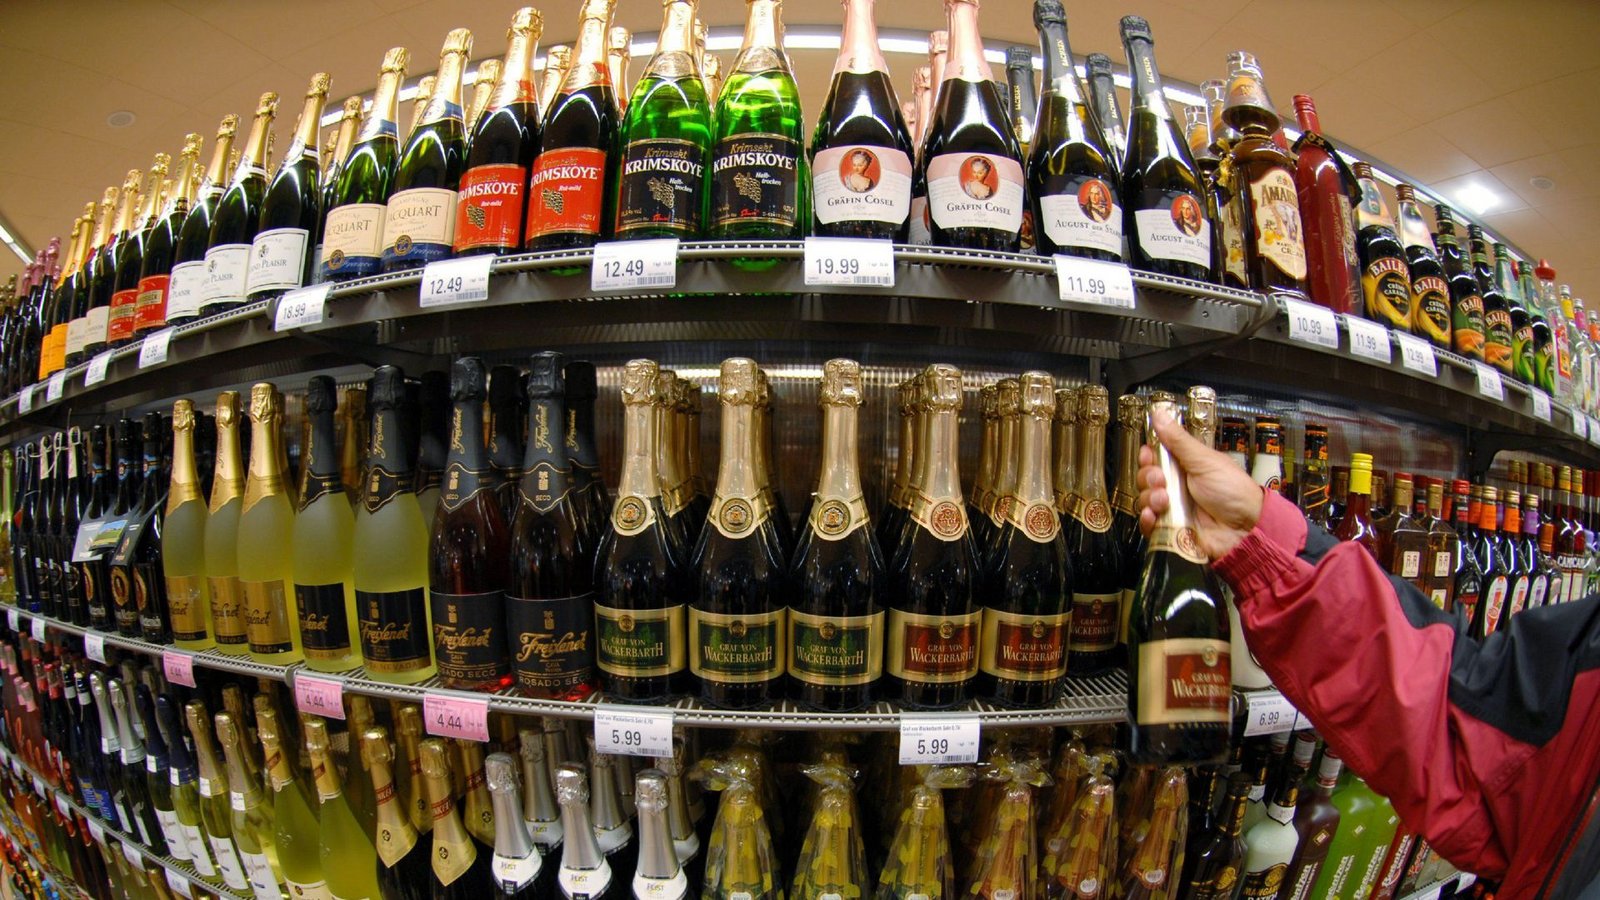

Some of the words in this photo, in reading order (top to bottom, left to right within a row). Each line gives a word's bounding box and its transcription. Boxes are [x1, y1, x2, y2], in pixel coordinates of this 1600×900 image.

[645, 147, 688, 160] Krimsekt
[730, 143, 774, 155] Krimsekt
[625, 158, 703, 178] KRIMSKOYE
[714, 152, 793, 174] KRIMSKOYE
[827, 196, 861, 207] GRÄFIN
[865, 194, 894, 207] COSEL
[947, 202, 981, 212] GRÄFIN
[985, 202, 1011, 216] COSEL
[1055, 219, 1089, 229] AUGUST
[1150, 233, 1182, 243] AUGUST
[604, 259, 644, 277] 12.49
[816, 258, 859, 274] 19.99
[430, 276, 463, 294] 12.49
[1068, 276, 1106, 295] 11.99
[283, 303, 306, 321] 18.99
[1296, 316, 1322, 335] 10.99
[1355, 333, 1377, 351] 11.99
[1405, 348, 1424, 364] 12.99
[435, 624, 492, 650] Freixenet
[612, 636, 626, 645] GRAF
[630, 638, 646, 646] VON
[516, 631, 588, 663] Freixenet
[601, 638, 664, 658] WACKERBARTH
[704, 645, 773, 664] WACKERBARTH
[809, 644, 828, 652] GRAF
[830, 646, 848, 654] VON
[910, 645, 974, 664] WACKERBARTH
[1003, 645, 1063, 662] WACKERBARTH
[1019, 643, 1036, 651] GRAF
[796, 645, 864, 666] WACKERBARTH
[468, 668, 497, 678] SECO
[518, 676, 561, 687] ROSADO
[306, 695, 325, 707] 4.44
[437, 714, 462, 730] 4.44
[1259, 711, 1280, 726] 6.99
[612, 729, 642, 746] 5.99
[917, 739, 948, 755] 5.99
